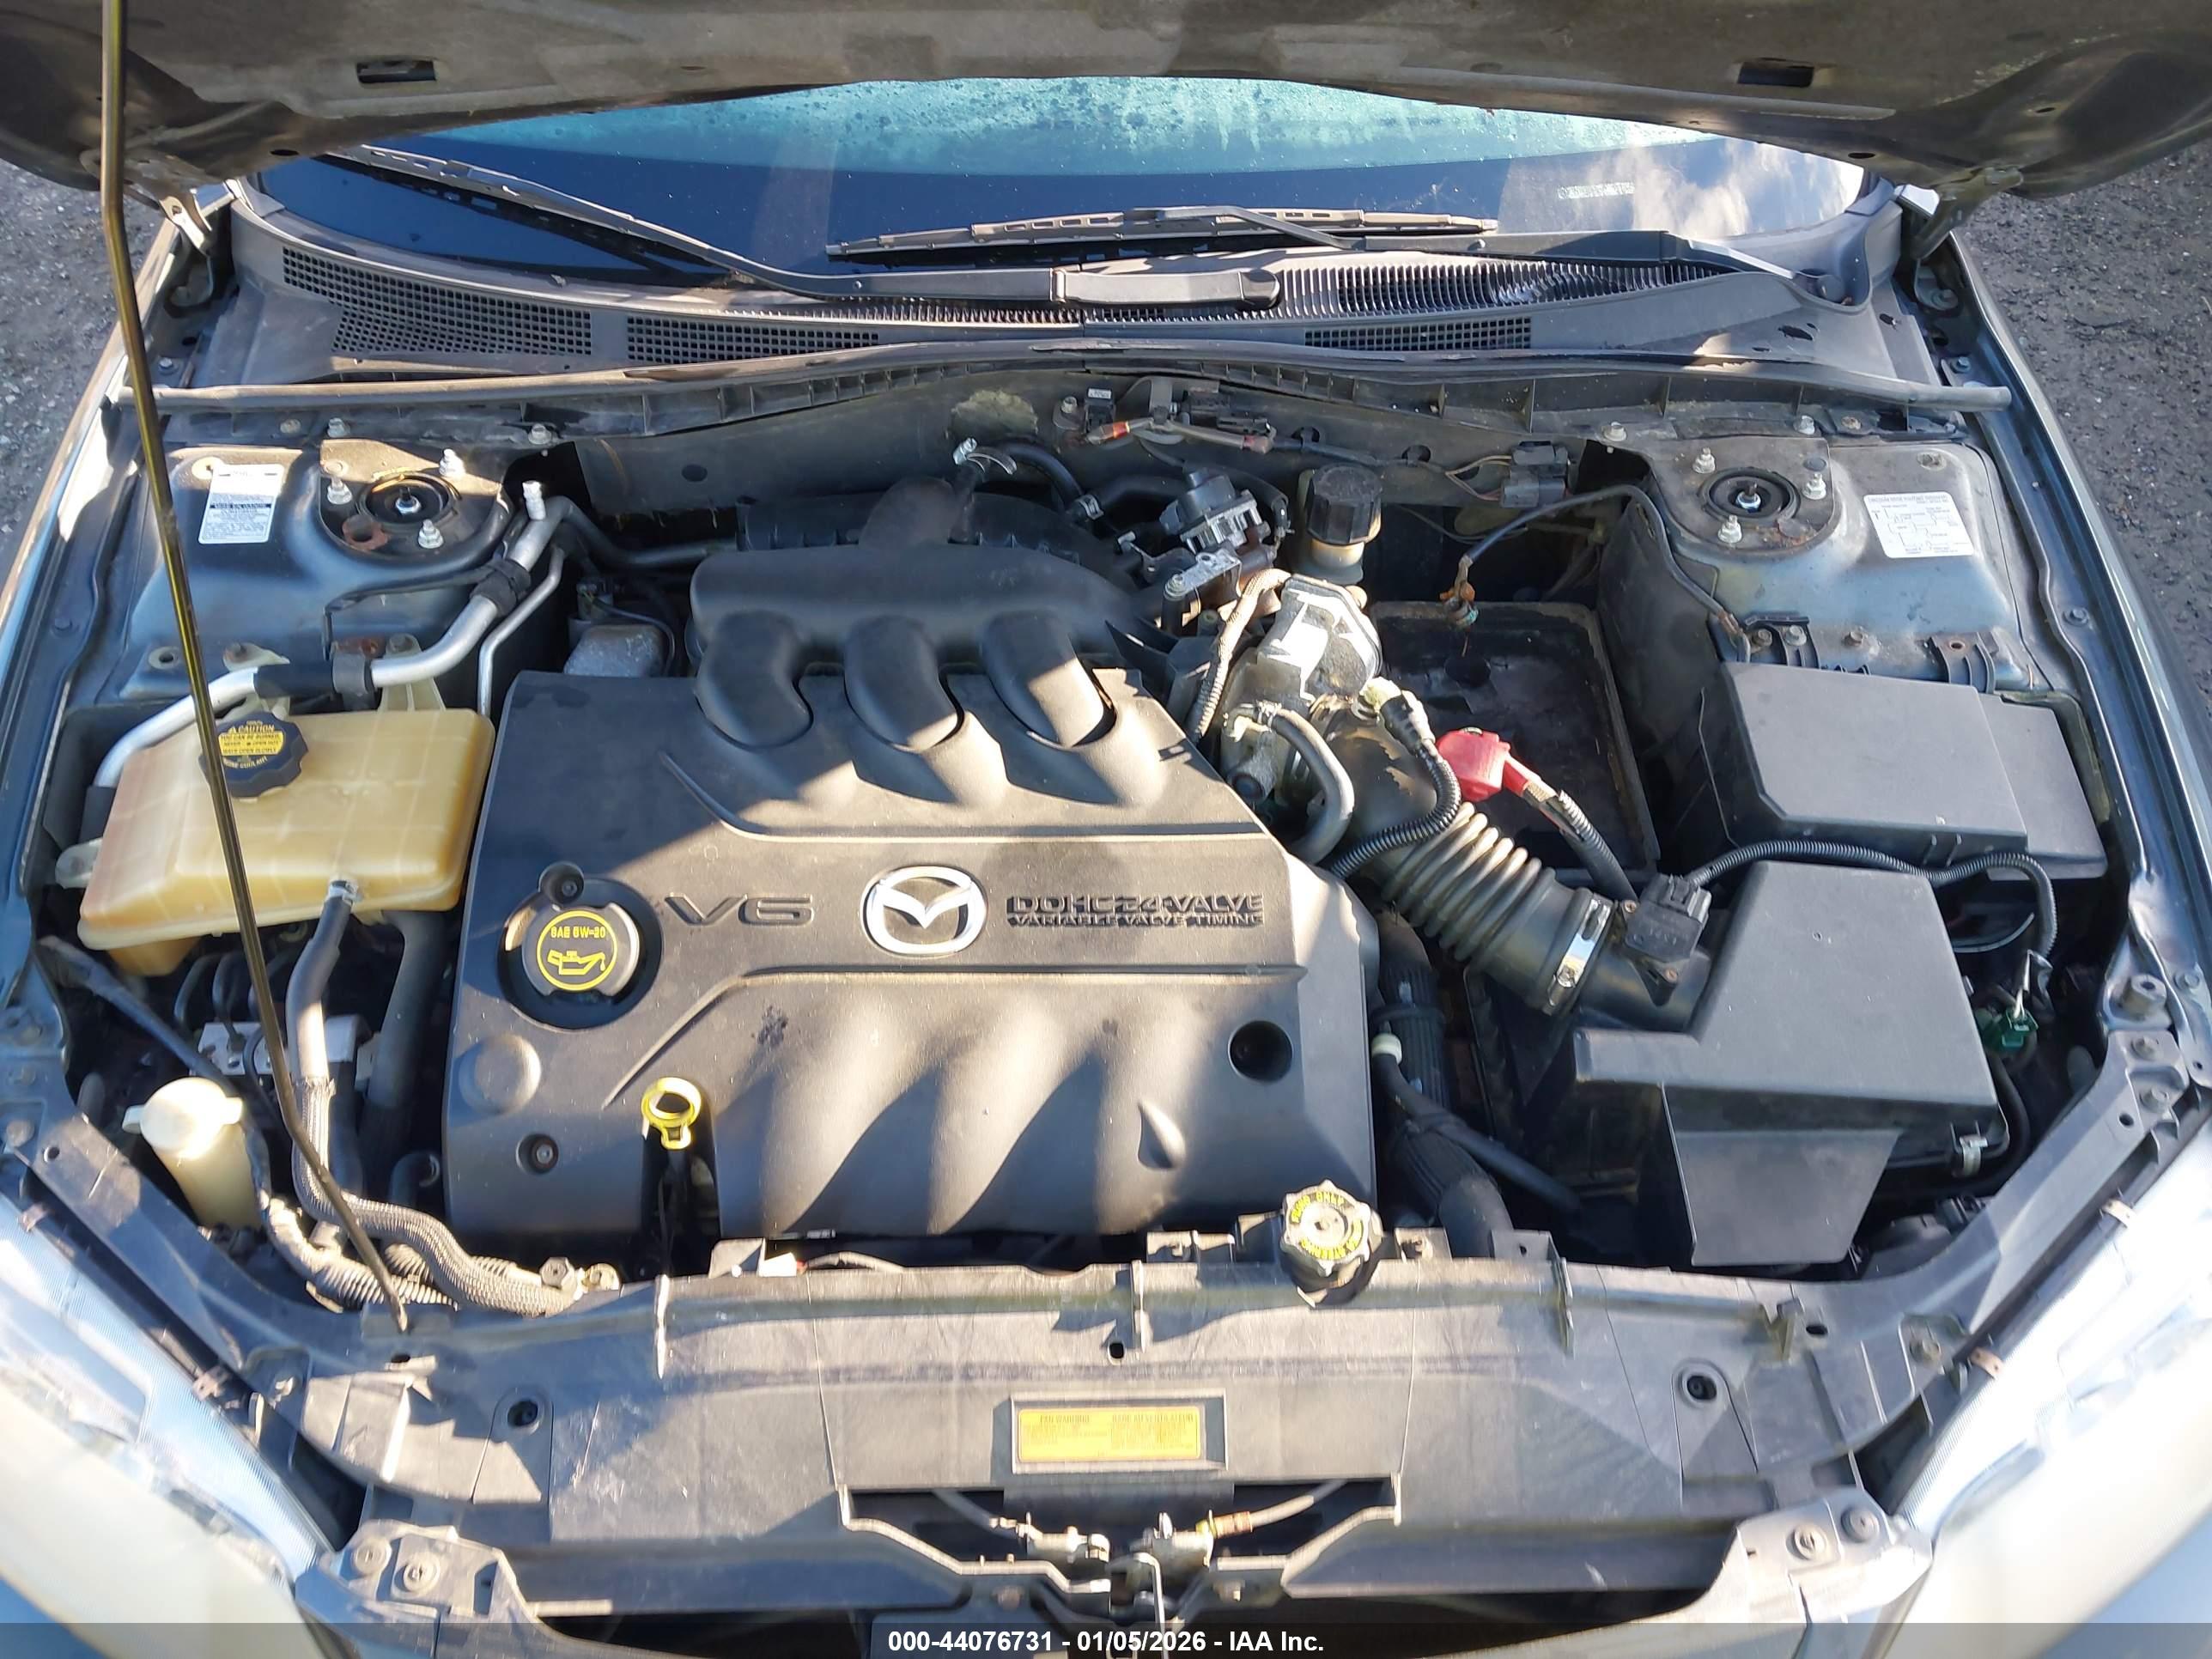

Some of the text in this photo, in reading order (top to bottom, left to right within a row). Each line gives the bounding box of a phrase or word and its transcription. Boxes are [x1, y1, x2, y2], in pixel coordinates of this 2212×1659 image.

[238, 724, 275, 733] CAUTION
[664, 894, 815, 927] V6
[1007, 894, 1115, 914] DOHC
[1118, 913, 1186, 927] VALVE
[1187, 913, 1264, 927] TIMING
